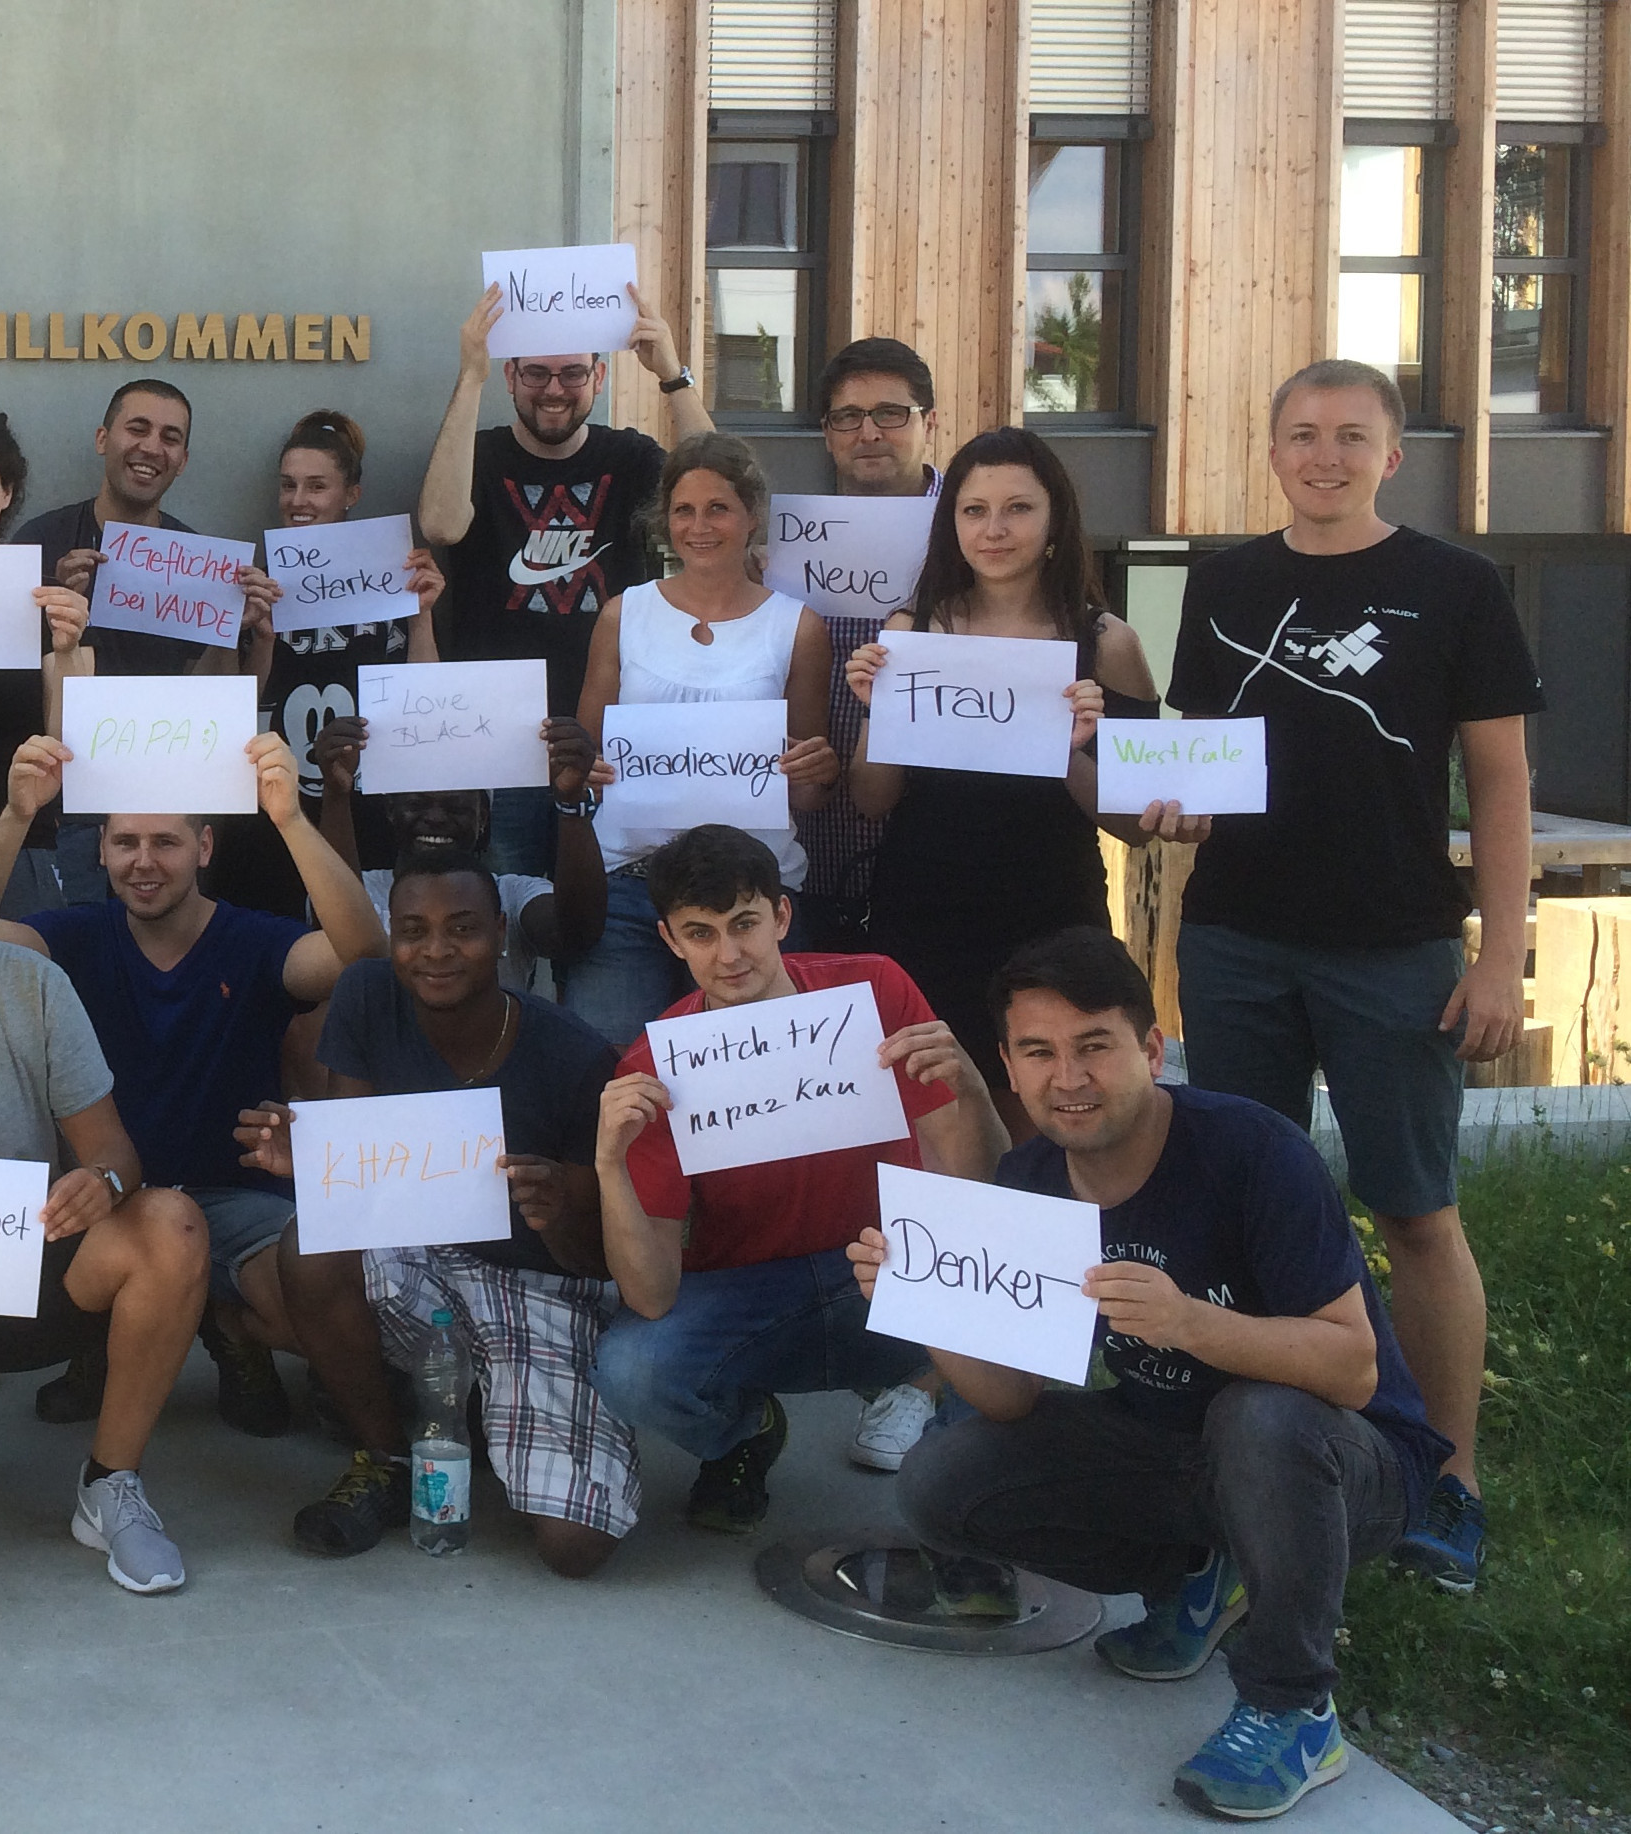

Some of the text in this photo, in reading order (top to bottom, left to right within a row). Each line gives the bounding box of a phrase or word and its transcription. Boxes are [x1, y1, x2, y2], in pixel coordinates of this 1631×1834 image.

[509, 268, 621, 312] Neue Ideen
[523, 529, 595, 565] NIKE
[777, 512, 850, 543] Der
[273, 543, 331, 569] Die
[296, 568, 403, 604] Starke
[803, 559, 902, 605] Neue
[109, 583, 234, 638] bei VAUDE
[362, 675, 394, 704] I
[894, 669, 1015, 723] Frau
[89, 717, 192, 761] PAPA
[389, 714, 494, 747] BLACK
[607, 736, 786, 798] Paradiesvogel
[321, 1133, 505, 1199] KHALIM
[890, 1217, 1081, 1310] Denker
[1101, 1242, 1168, 1270] ACH TIME
[1139, 1358, 1192, 1383] CLUB
